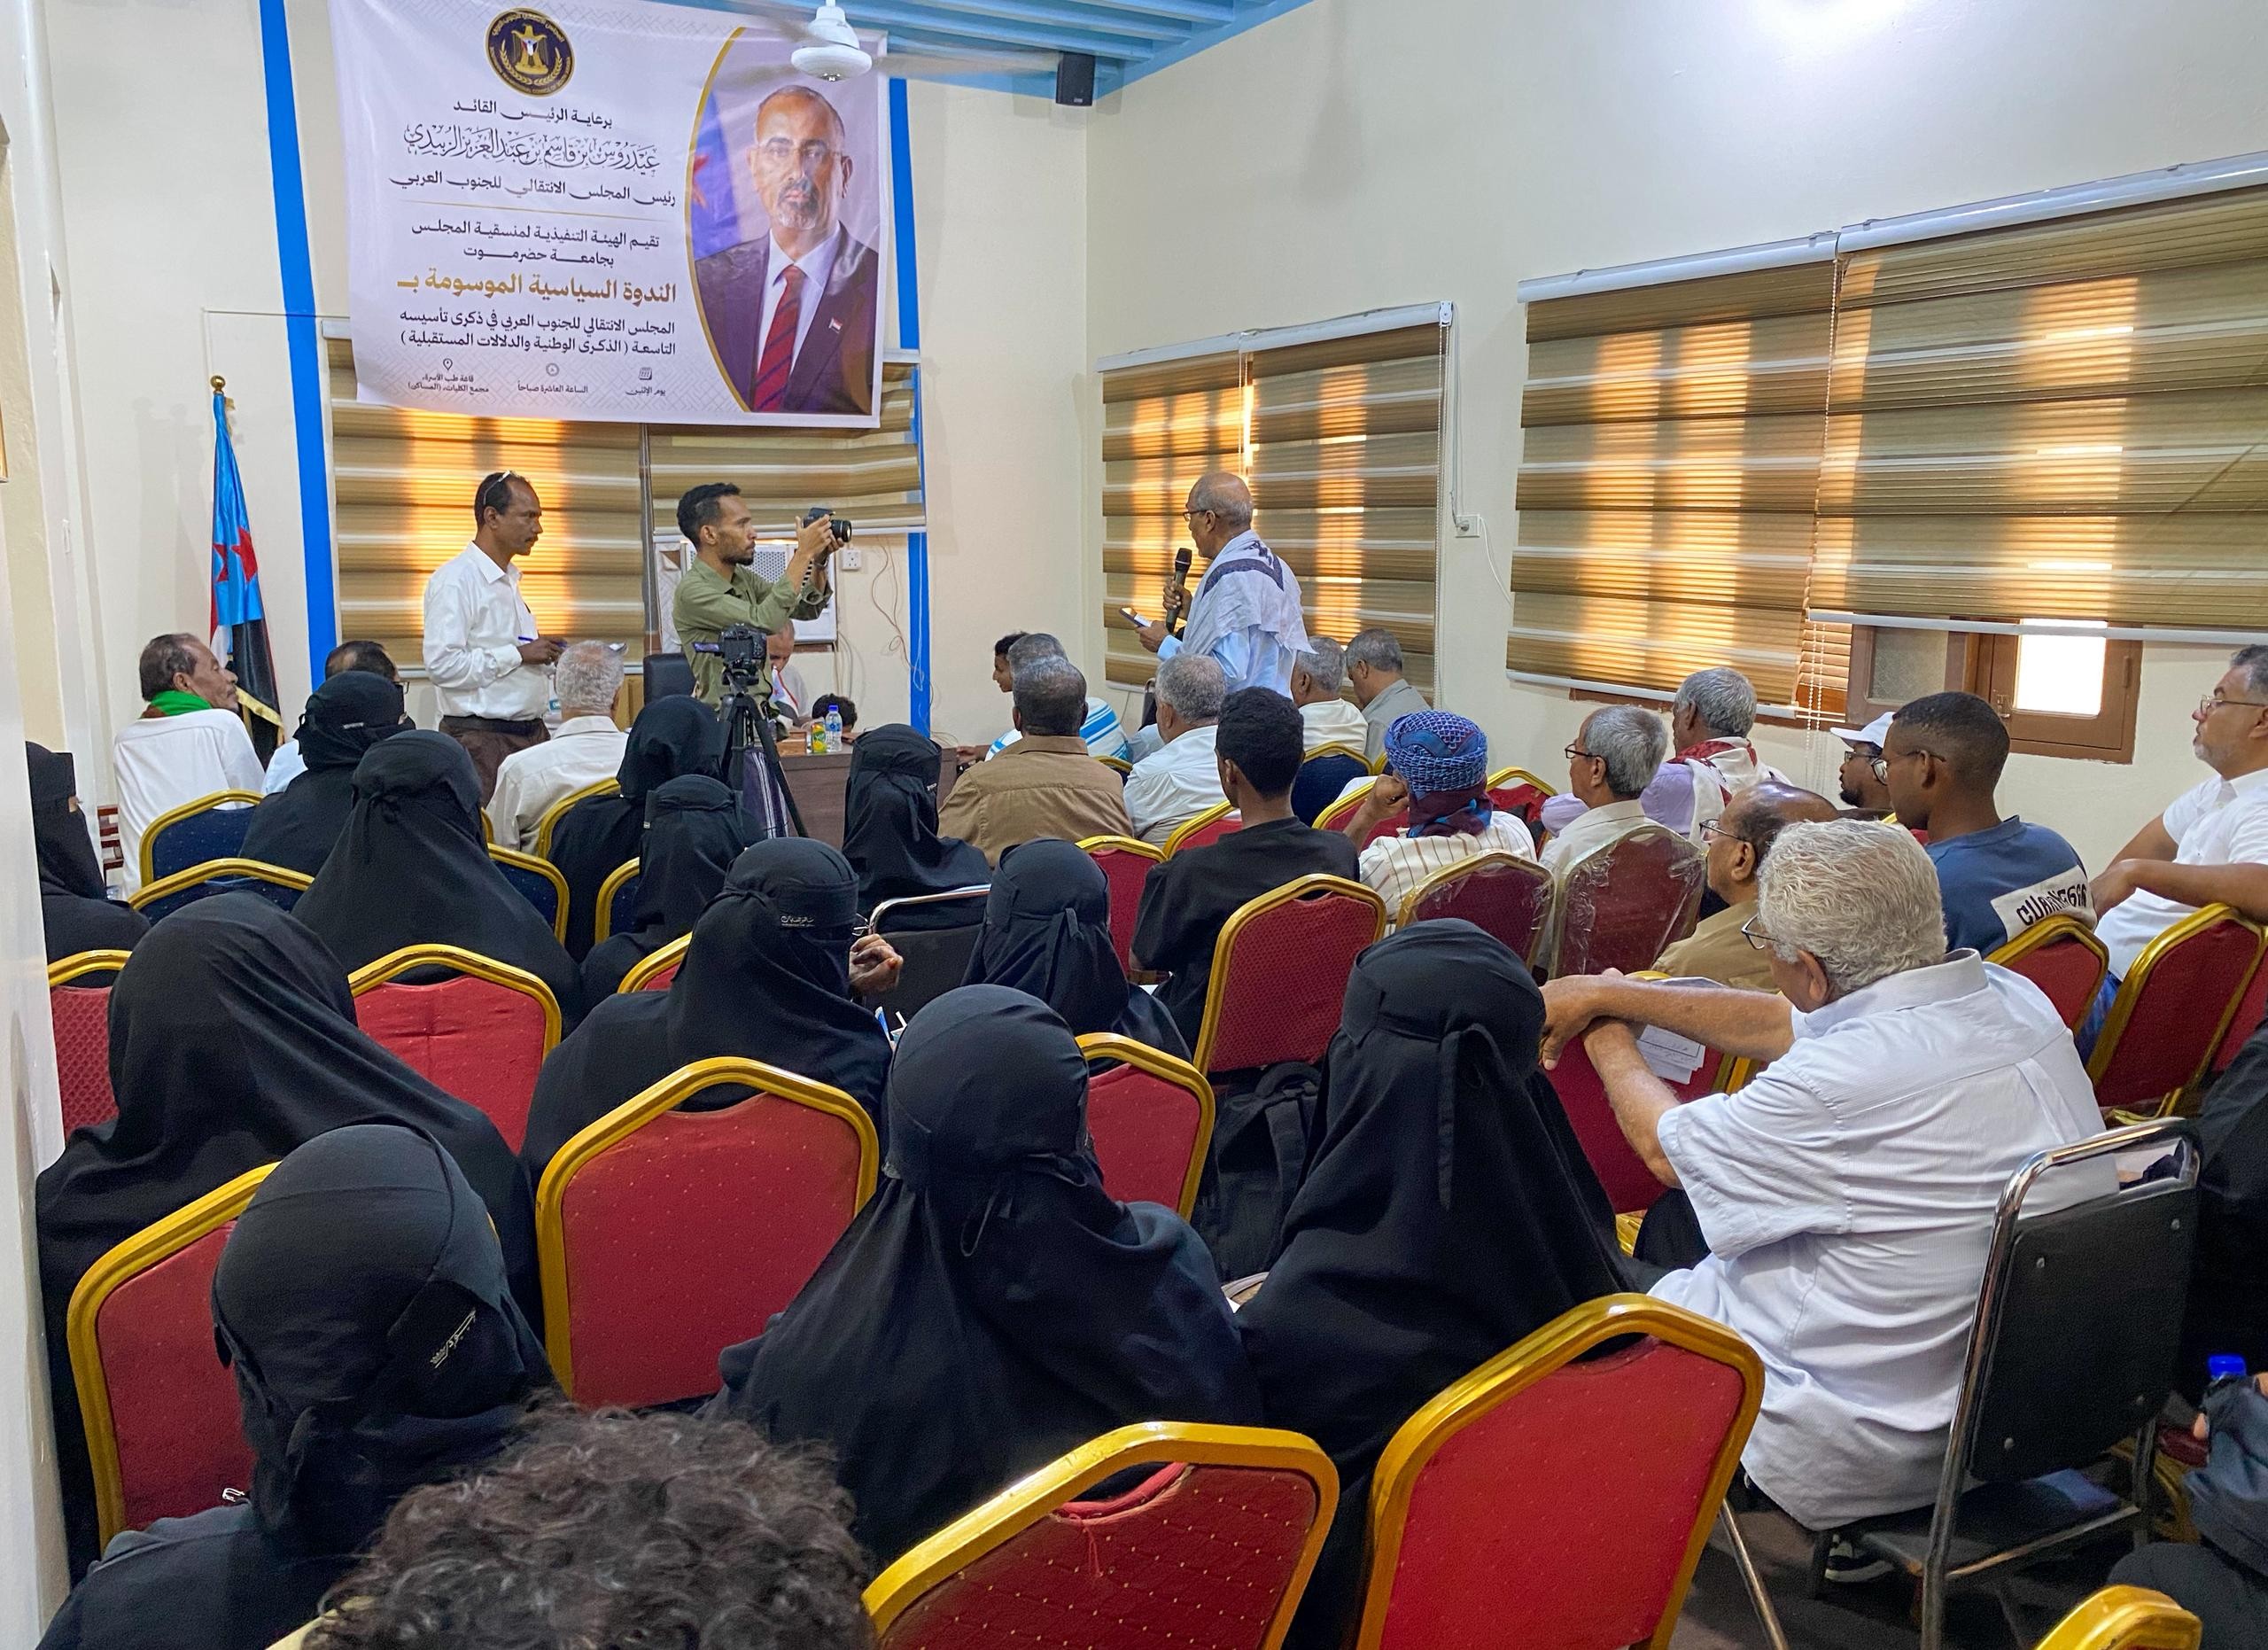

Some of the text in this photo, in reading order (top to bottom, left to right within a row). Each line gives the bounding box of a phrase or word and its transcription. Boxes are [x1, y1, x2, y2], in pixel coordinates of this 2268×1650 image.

[454, 98, 612, 128] برعاية الرئيس القائد
[389, 169, 676, 206] رئيس المجلس الانتقالي للجنوب العربي
[411, 218, 660, 250] تقيم الهيئة التنفيذية لمنسقية المجلس
[463, 247, 614, 269] بجامعة حضرموت
[424, 268, 523, 299] الموسومة
[528, 273, 617, 303] السياسية
[623, 281, 677, 307] الندوة
[400, 307, 675, 338] المجلس الانتقالي للجنوب العربي في ذكرى تأسيسه
[477, 333, 531, 351] والدلالات
[533, 336, 575, 353] الوطنية
[632, 340, 676, 355] التاسعة
[540, 384, 563, 394] العاشرة
[565, 385, 588, 393] الساعة
